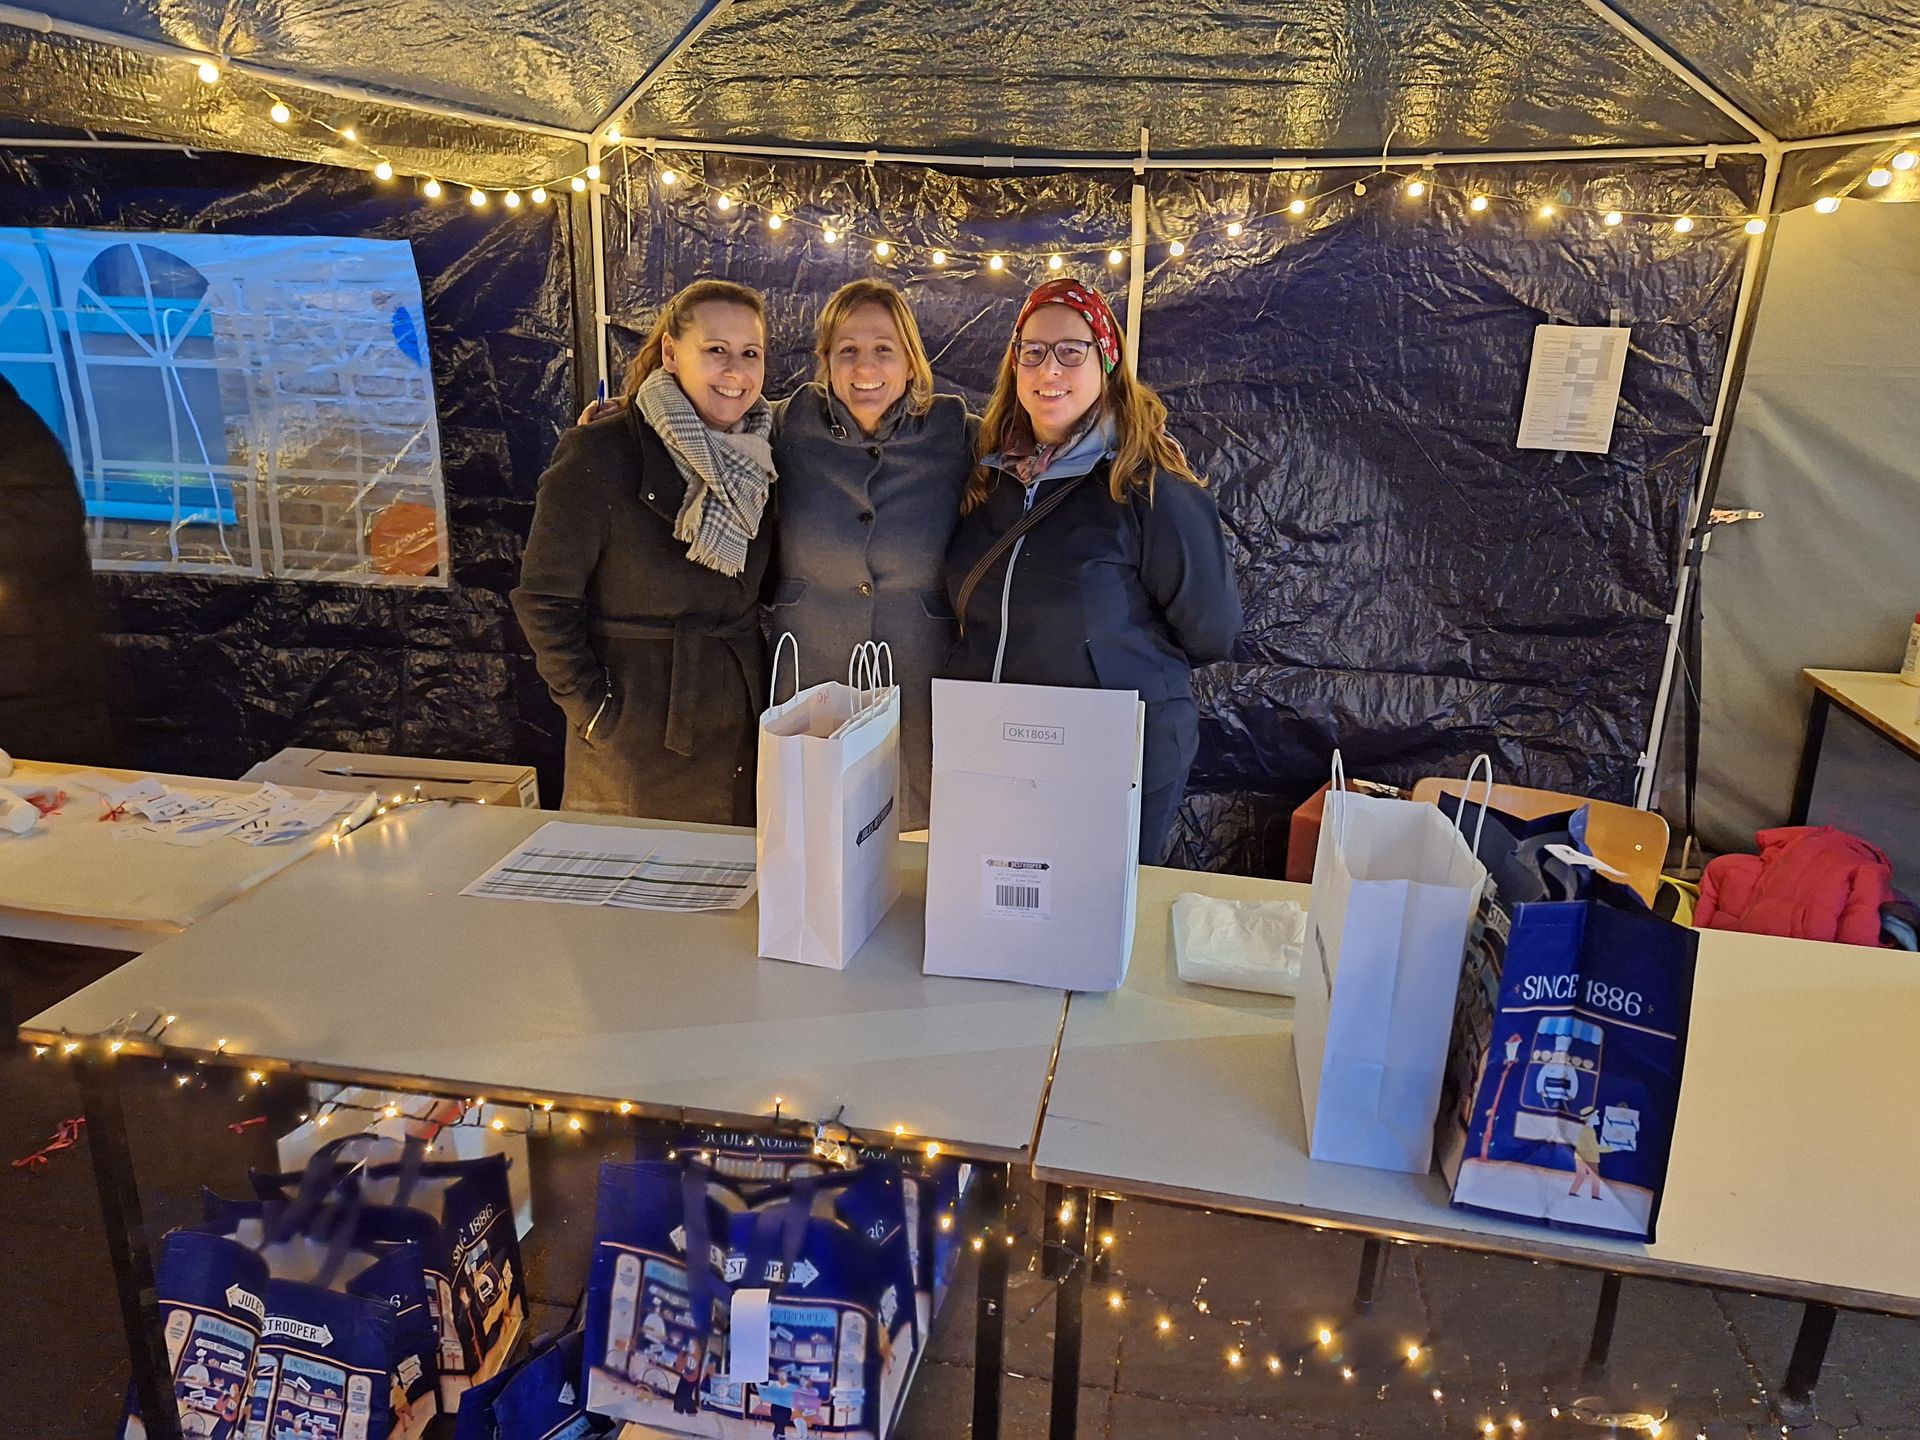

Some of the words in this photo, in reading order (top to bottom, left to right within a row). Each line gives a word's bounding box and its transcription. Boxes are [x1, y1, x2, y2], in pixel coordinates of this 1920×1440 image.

[1008, 727, 1057, 740] OK18054
[1522, 974, 1579, 1000] SINCE
[1585, 979, 1642, 1016] 1886
[468, 1203, 493, 1236] 1886
